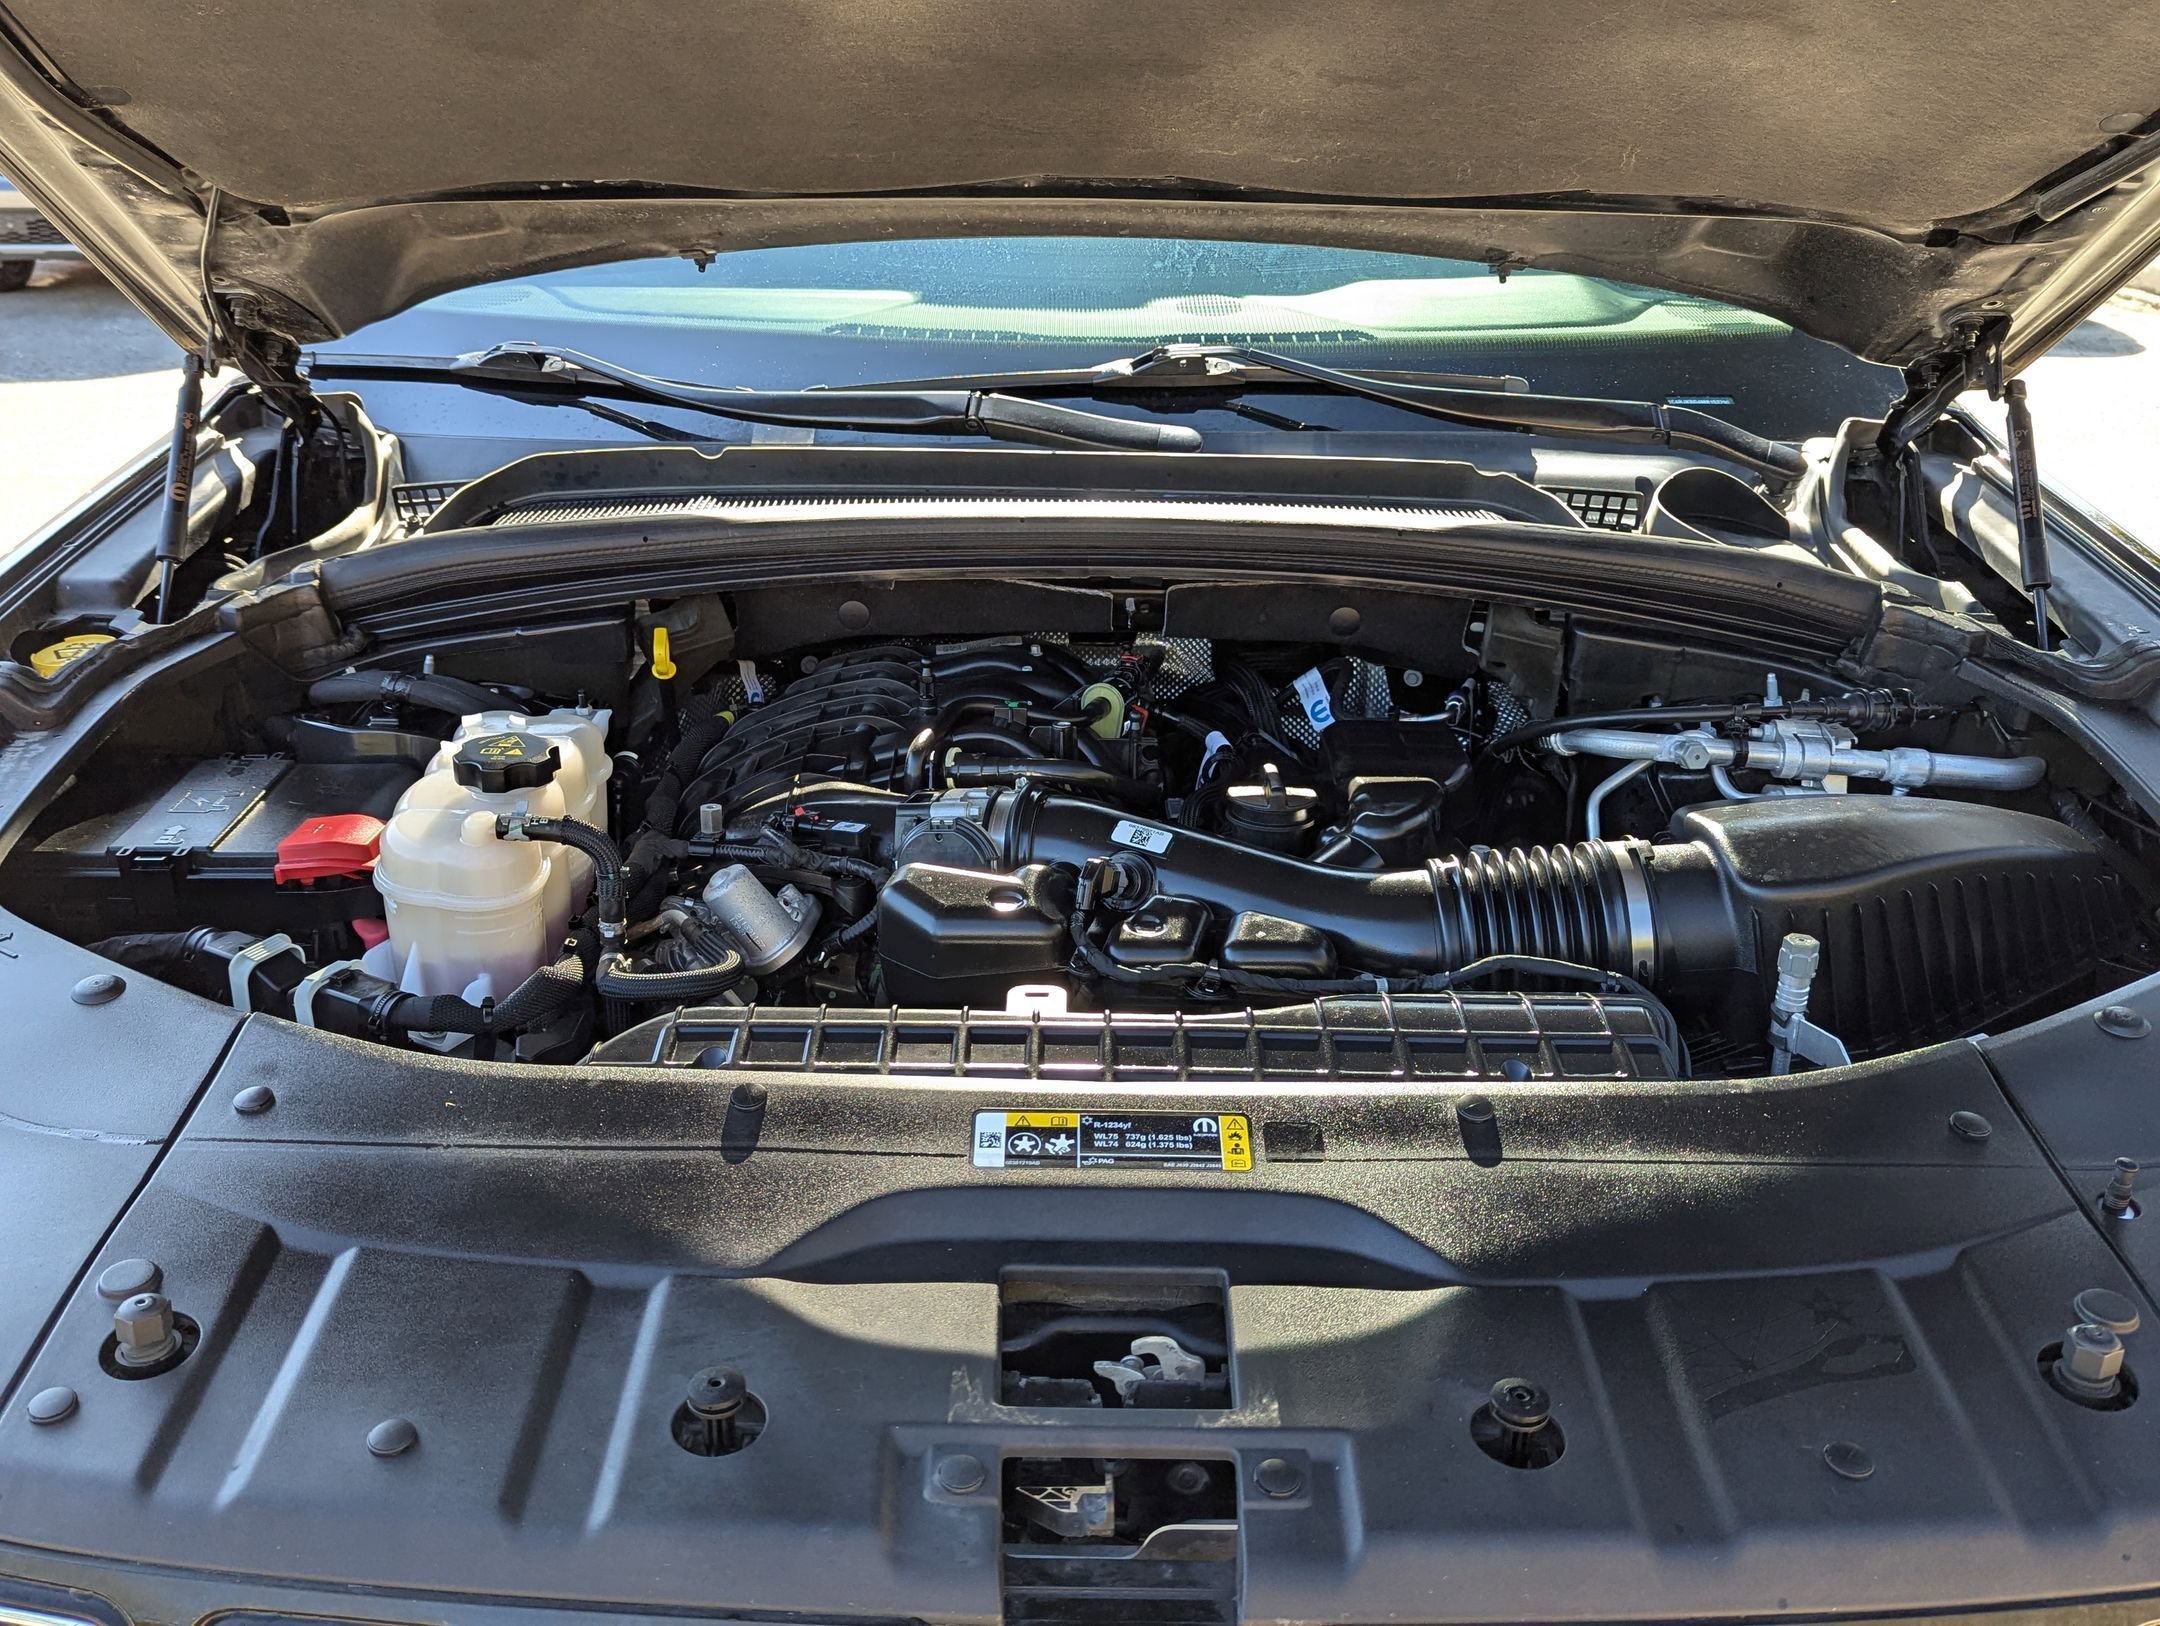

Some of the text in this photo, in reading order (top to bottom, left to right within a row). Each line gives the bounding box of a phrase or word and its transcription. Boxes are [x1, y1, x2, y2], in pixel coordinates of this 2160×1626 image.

[1093, 1121, 1132, 1130] R-1234yf
[1125, 1133, 1146, 1141] 737g
[1148, 1133, 1174, 1142] (1.625
[1175, 1134, 1193, 1142] lbs)
[1093, 1140, 1193, 1150] WL74 624g (1.375 lbs)
